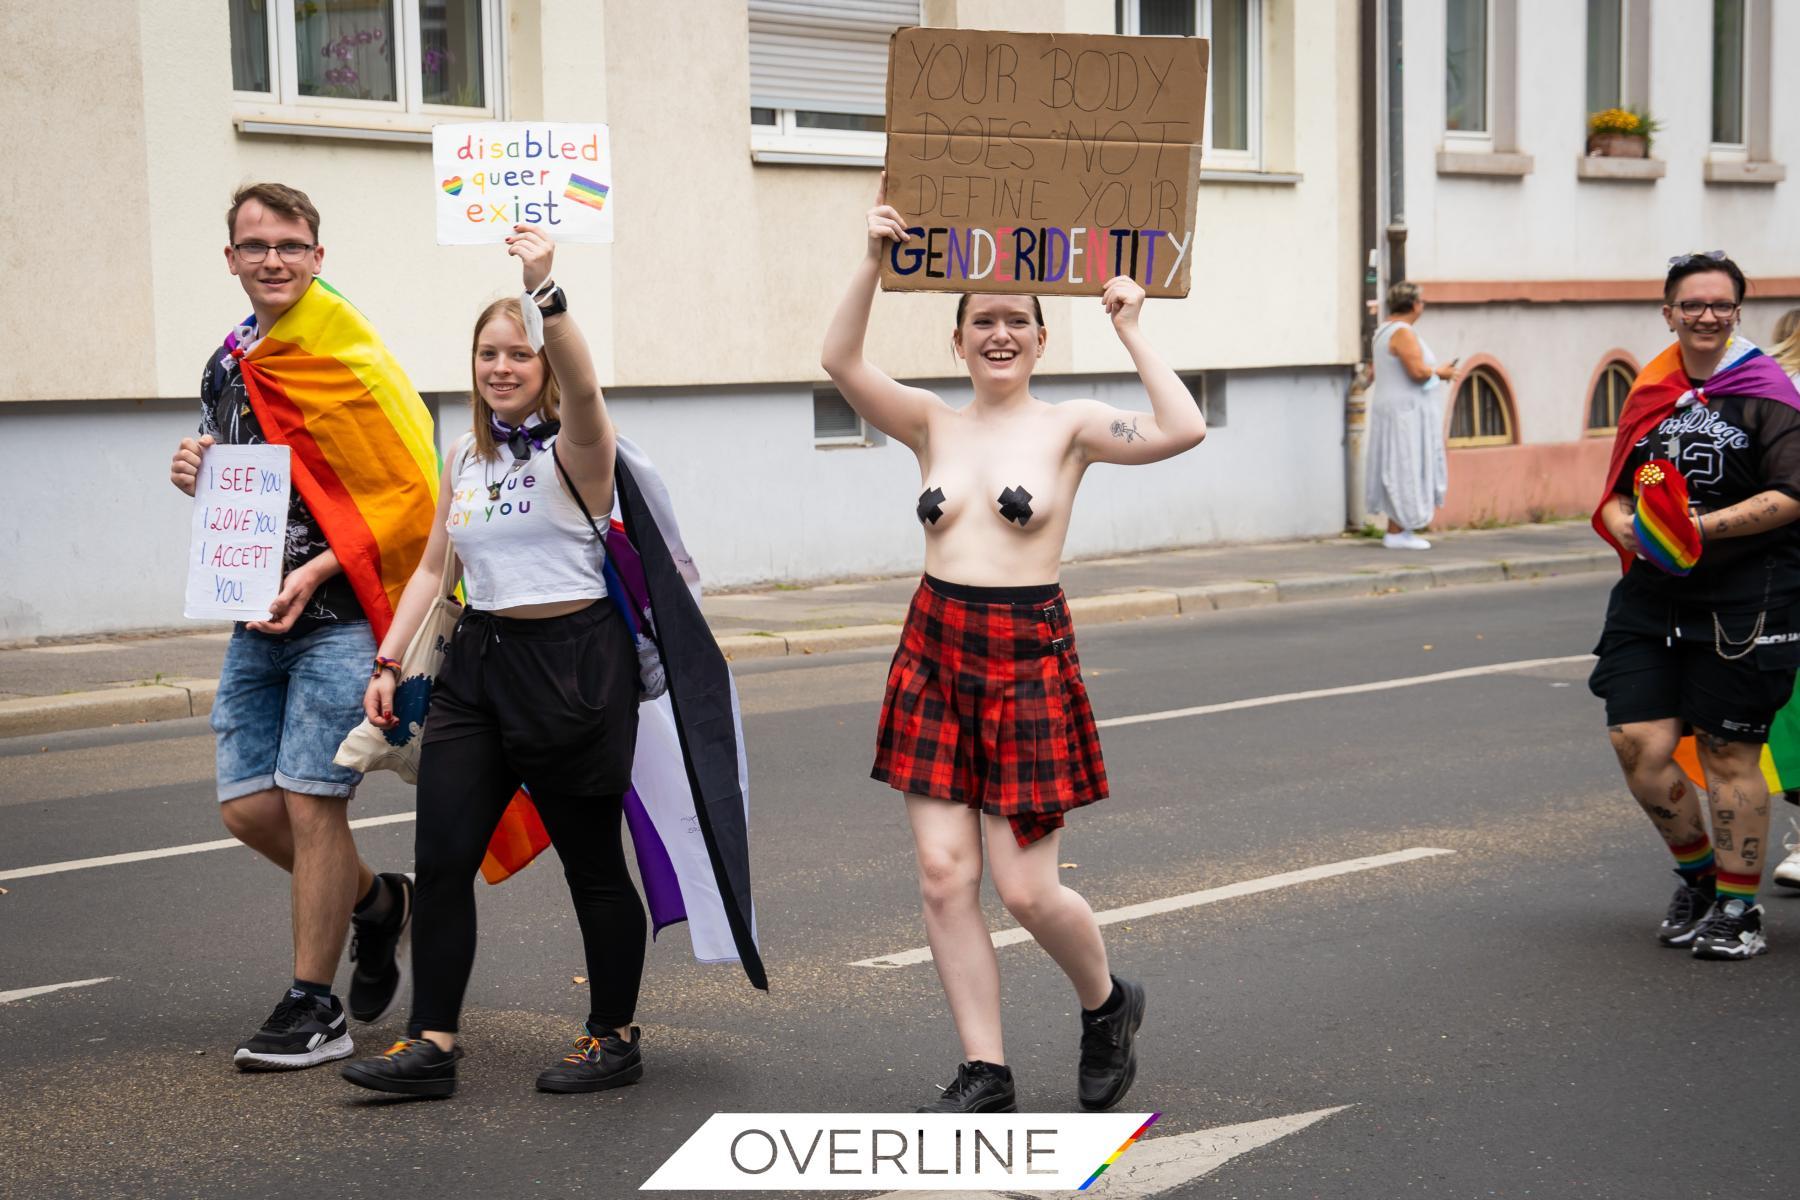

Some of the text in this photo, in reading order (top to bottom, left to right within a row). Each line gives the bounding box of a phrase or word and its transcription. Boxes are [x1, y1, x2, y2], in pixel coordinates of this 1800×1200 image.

[910, 40, 1175, 114] YOUR BODY
[457, 129, 598, 161] disabled
[910, 112, 1190, 178] DOES NOT
[472, 169, 550, 194] queer
[466, 190, 562, 225] exist
[905, 174, 1179, 232] DEFINE YOUR
[891, 226, 1192, 288] GENDERIDENTITY
[1681, 407, 1749, 449] Diego
[209, 466, 214, 490] I
[219, 467, 256, 493] SEE
[203, 506, 209, 529] I
[485, 500, 531, 523] you
[201, 541, 273, 569] I ACCEPT
